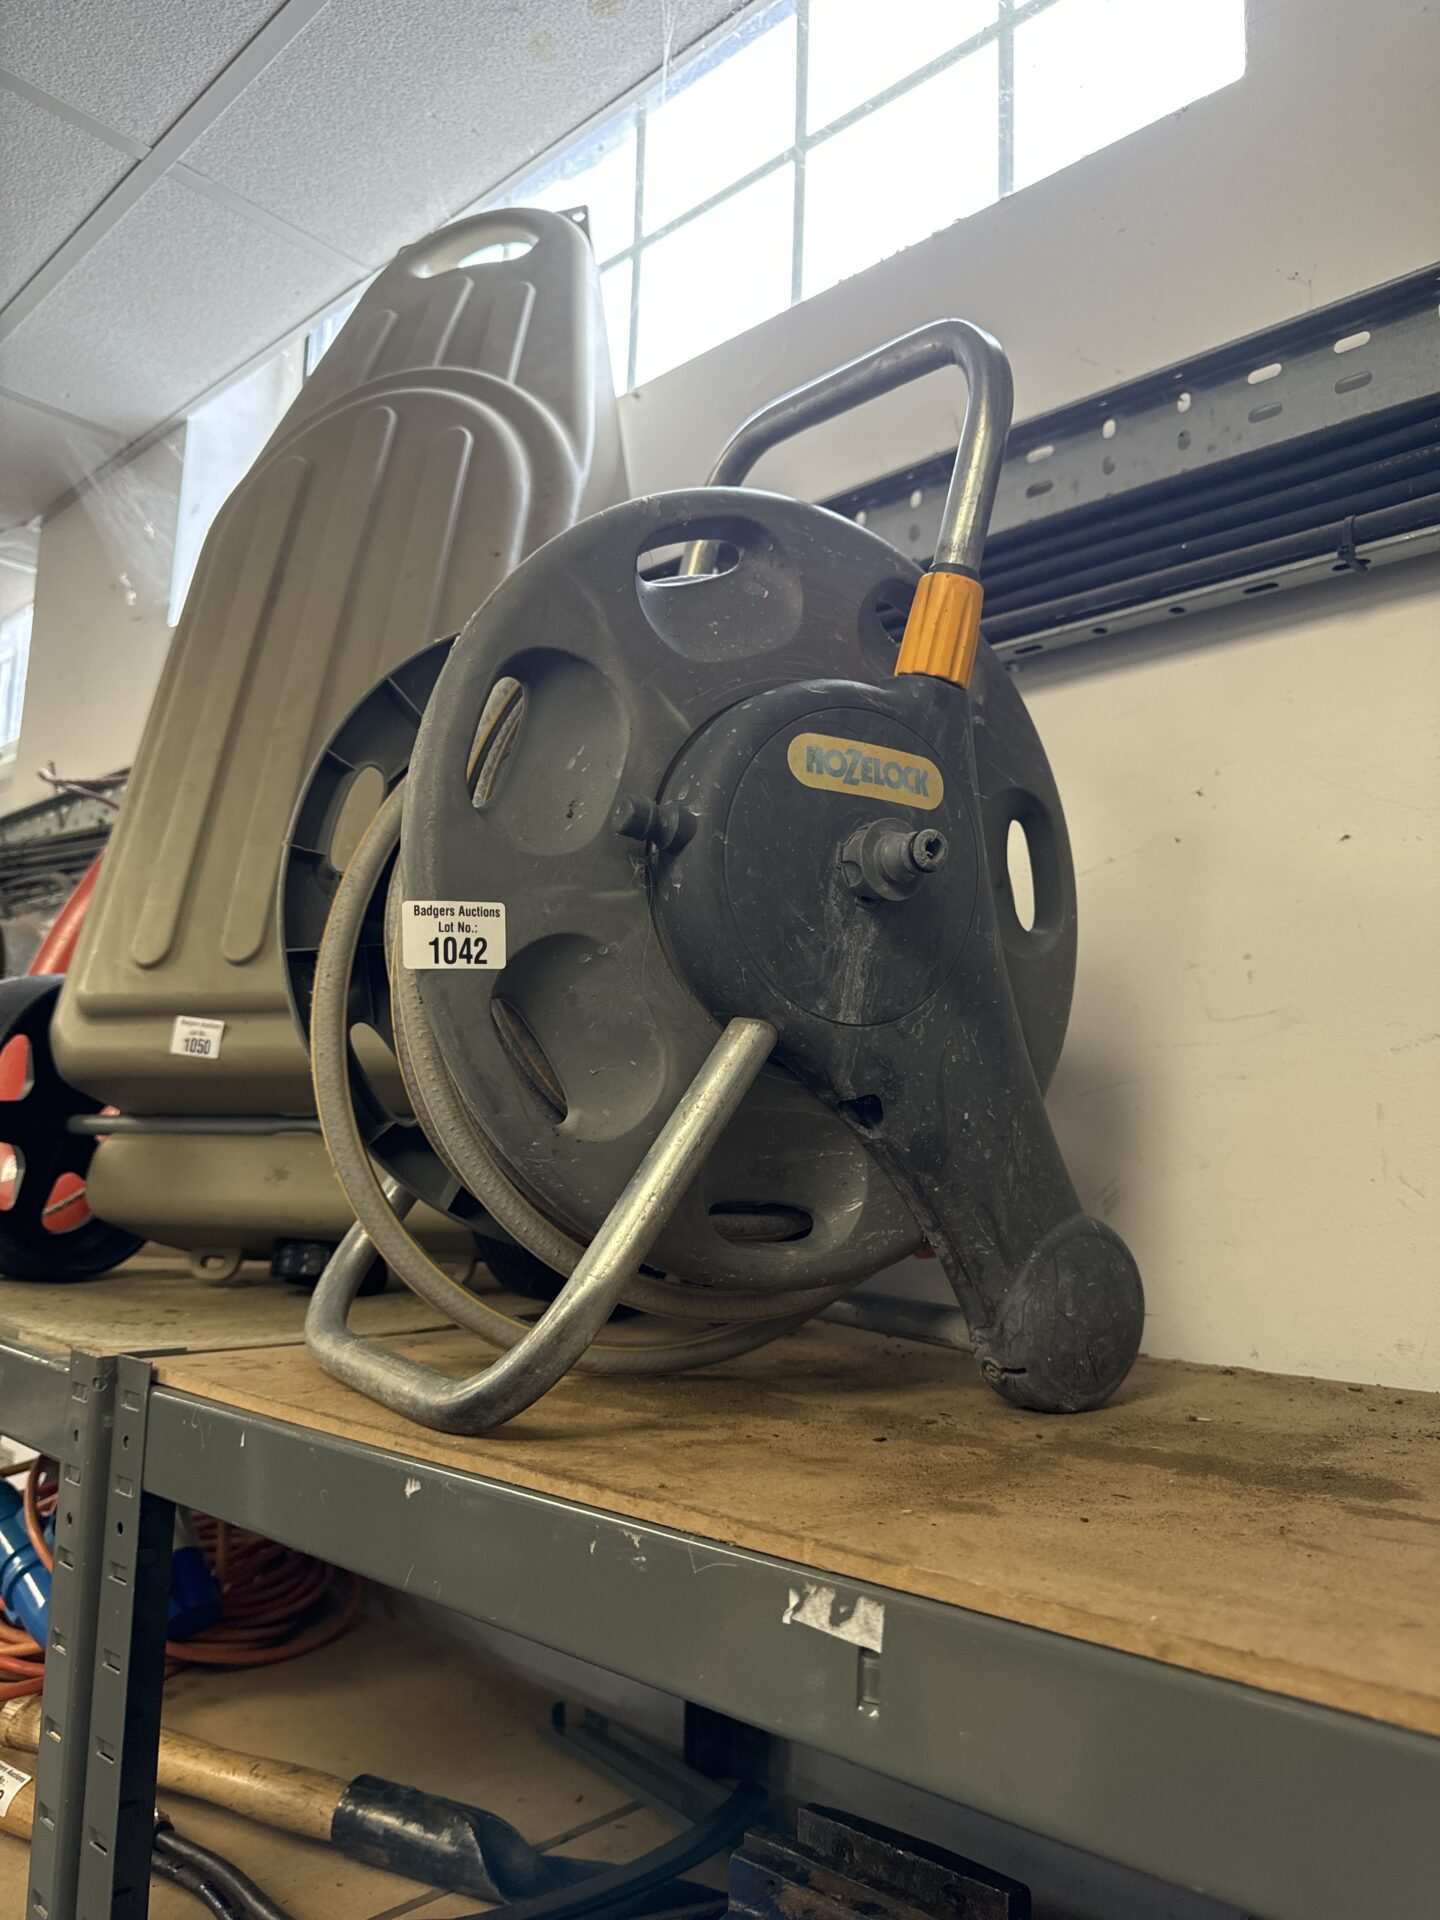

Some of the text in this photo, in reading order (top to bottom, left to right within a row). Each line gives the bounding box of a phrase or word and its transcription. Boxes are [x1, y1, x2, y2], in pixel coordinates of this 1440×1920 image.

[805, 745, 930, 798] HOZELOCK
[413, 904, 501, 919] Badgers Auctions
[438, 921, 478, 934] Lot No.:
[428, 936, 488, 965] 1042
[184, 1037, 212, 1055] 1050
